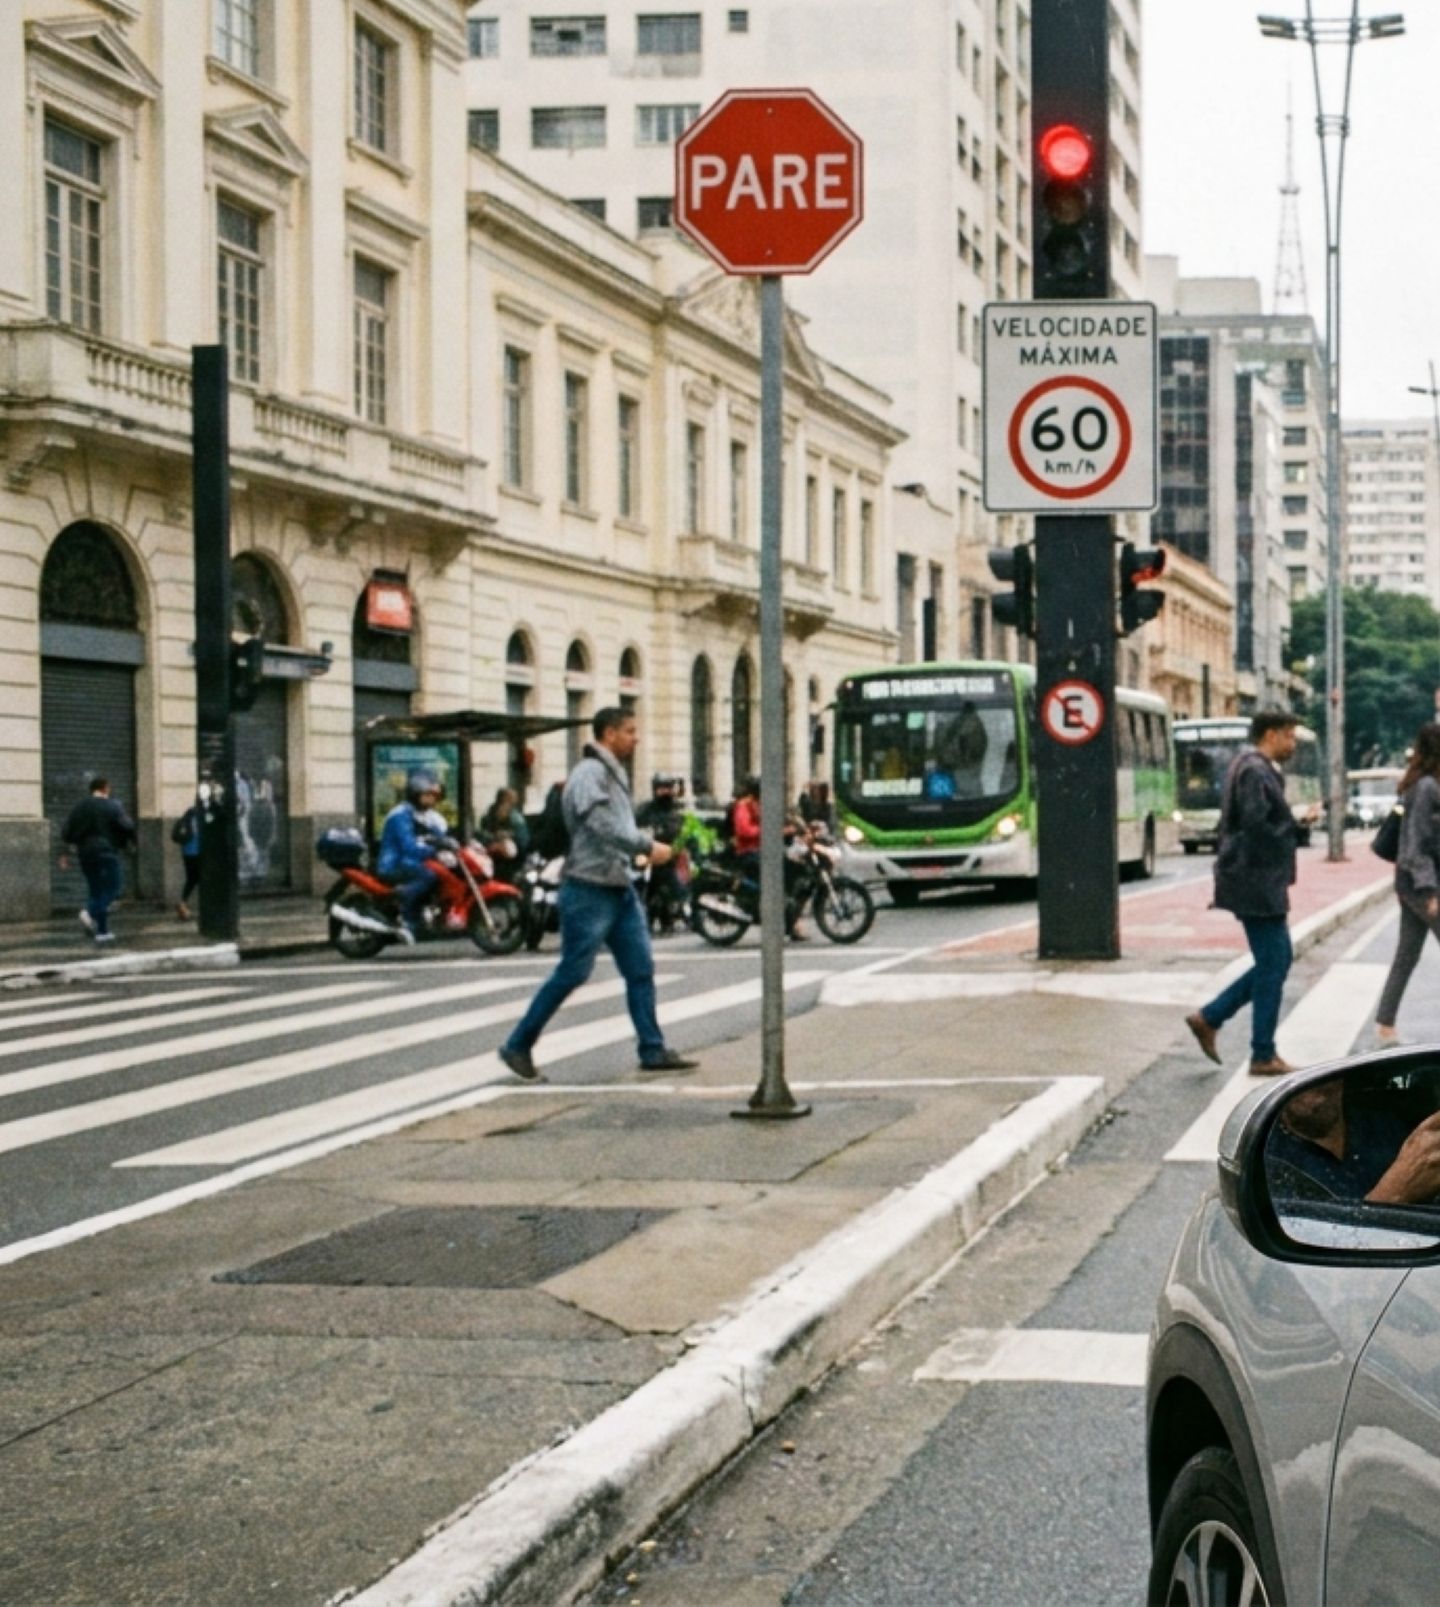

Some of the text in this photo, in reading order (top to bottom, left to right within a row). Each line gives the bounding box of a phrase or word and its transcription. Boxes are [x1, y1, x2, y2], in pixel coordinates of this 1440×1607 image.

[690, 154, 848, 210] PARE
[992, 316, 1147, 337] VELOCIDADE
[1020, 341, 1118, 366] MÁXIMA
[1031, 406, 1108, 452] 60
[1044, 459, 1097, 474] km/h
[1063, 694, 1083, 728] E
